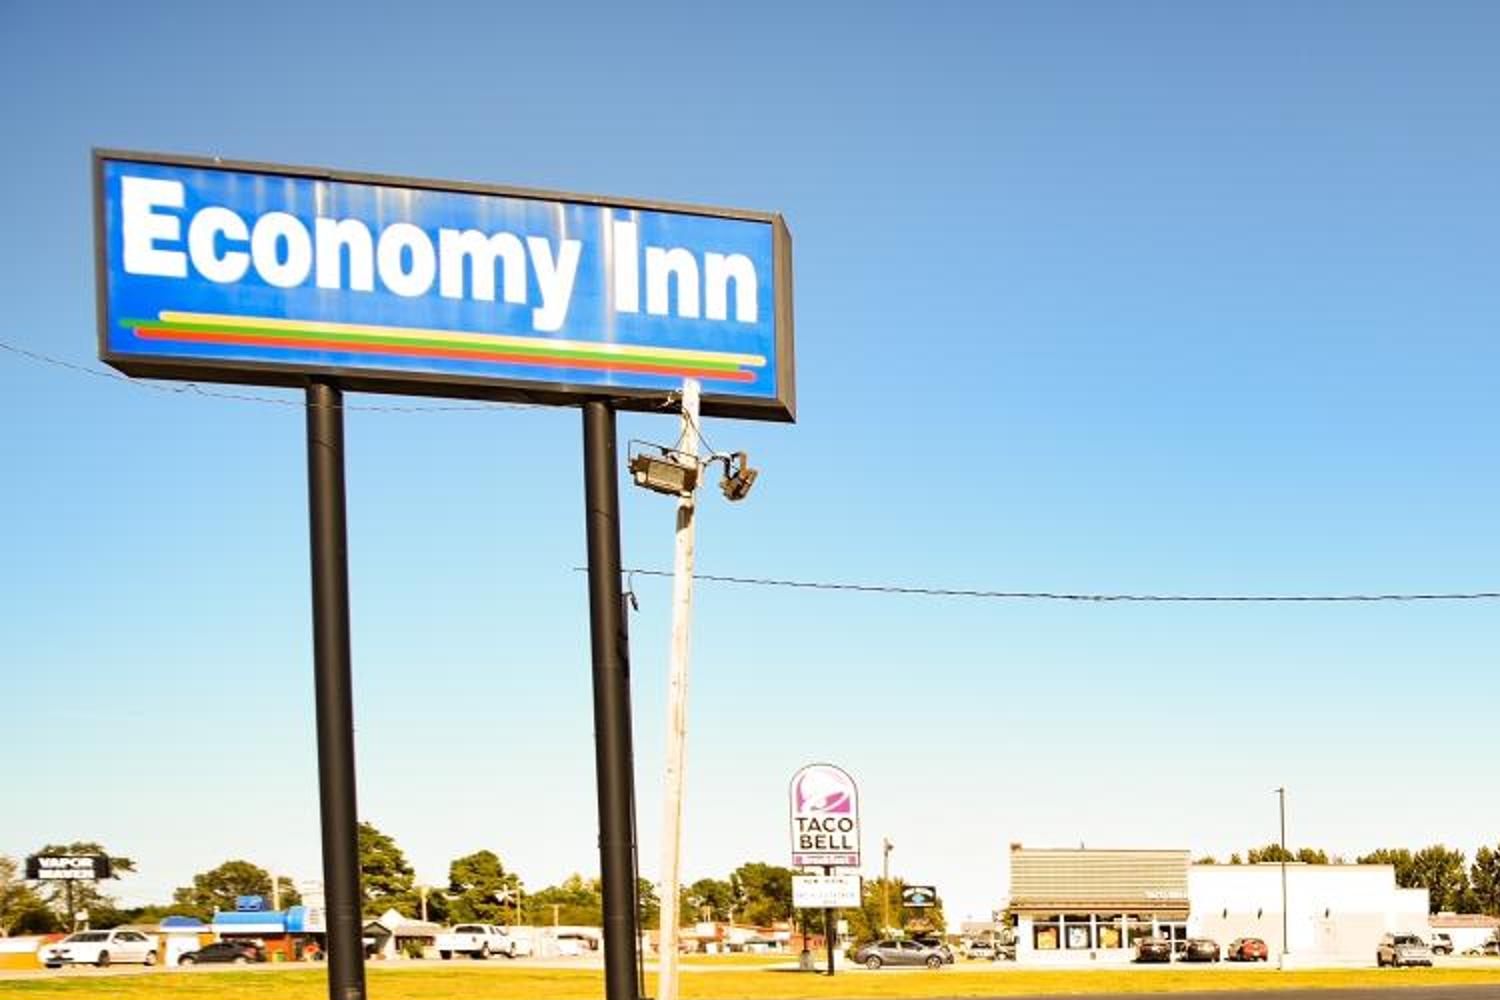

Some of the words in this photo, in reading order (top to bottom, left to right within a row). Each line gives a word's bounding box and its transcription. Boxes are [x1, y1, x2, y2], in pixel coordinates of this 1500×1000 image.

[121, 176, 582, 332] Economy
[613, 219, 757, 323] Inn
[794, 817, 853, 832] TACO
[799, 834, 853, 849] BELL
[38, 857, 94, 868] VAPOR
